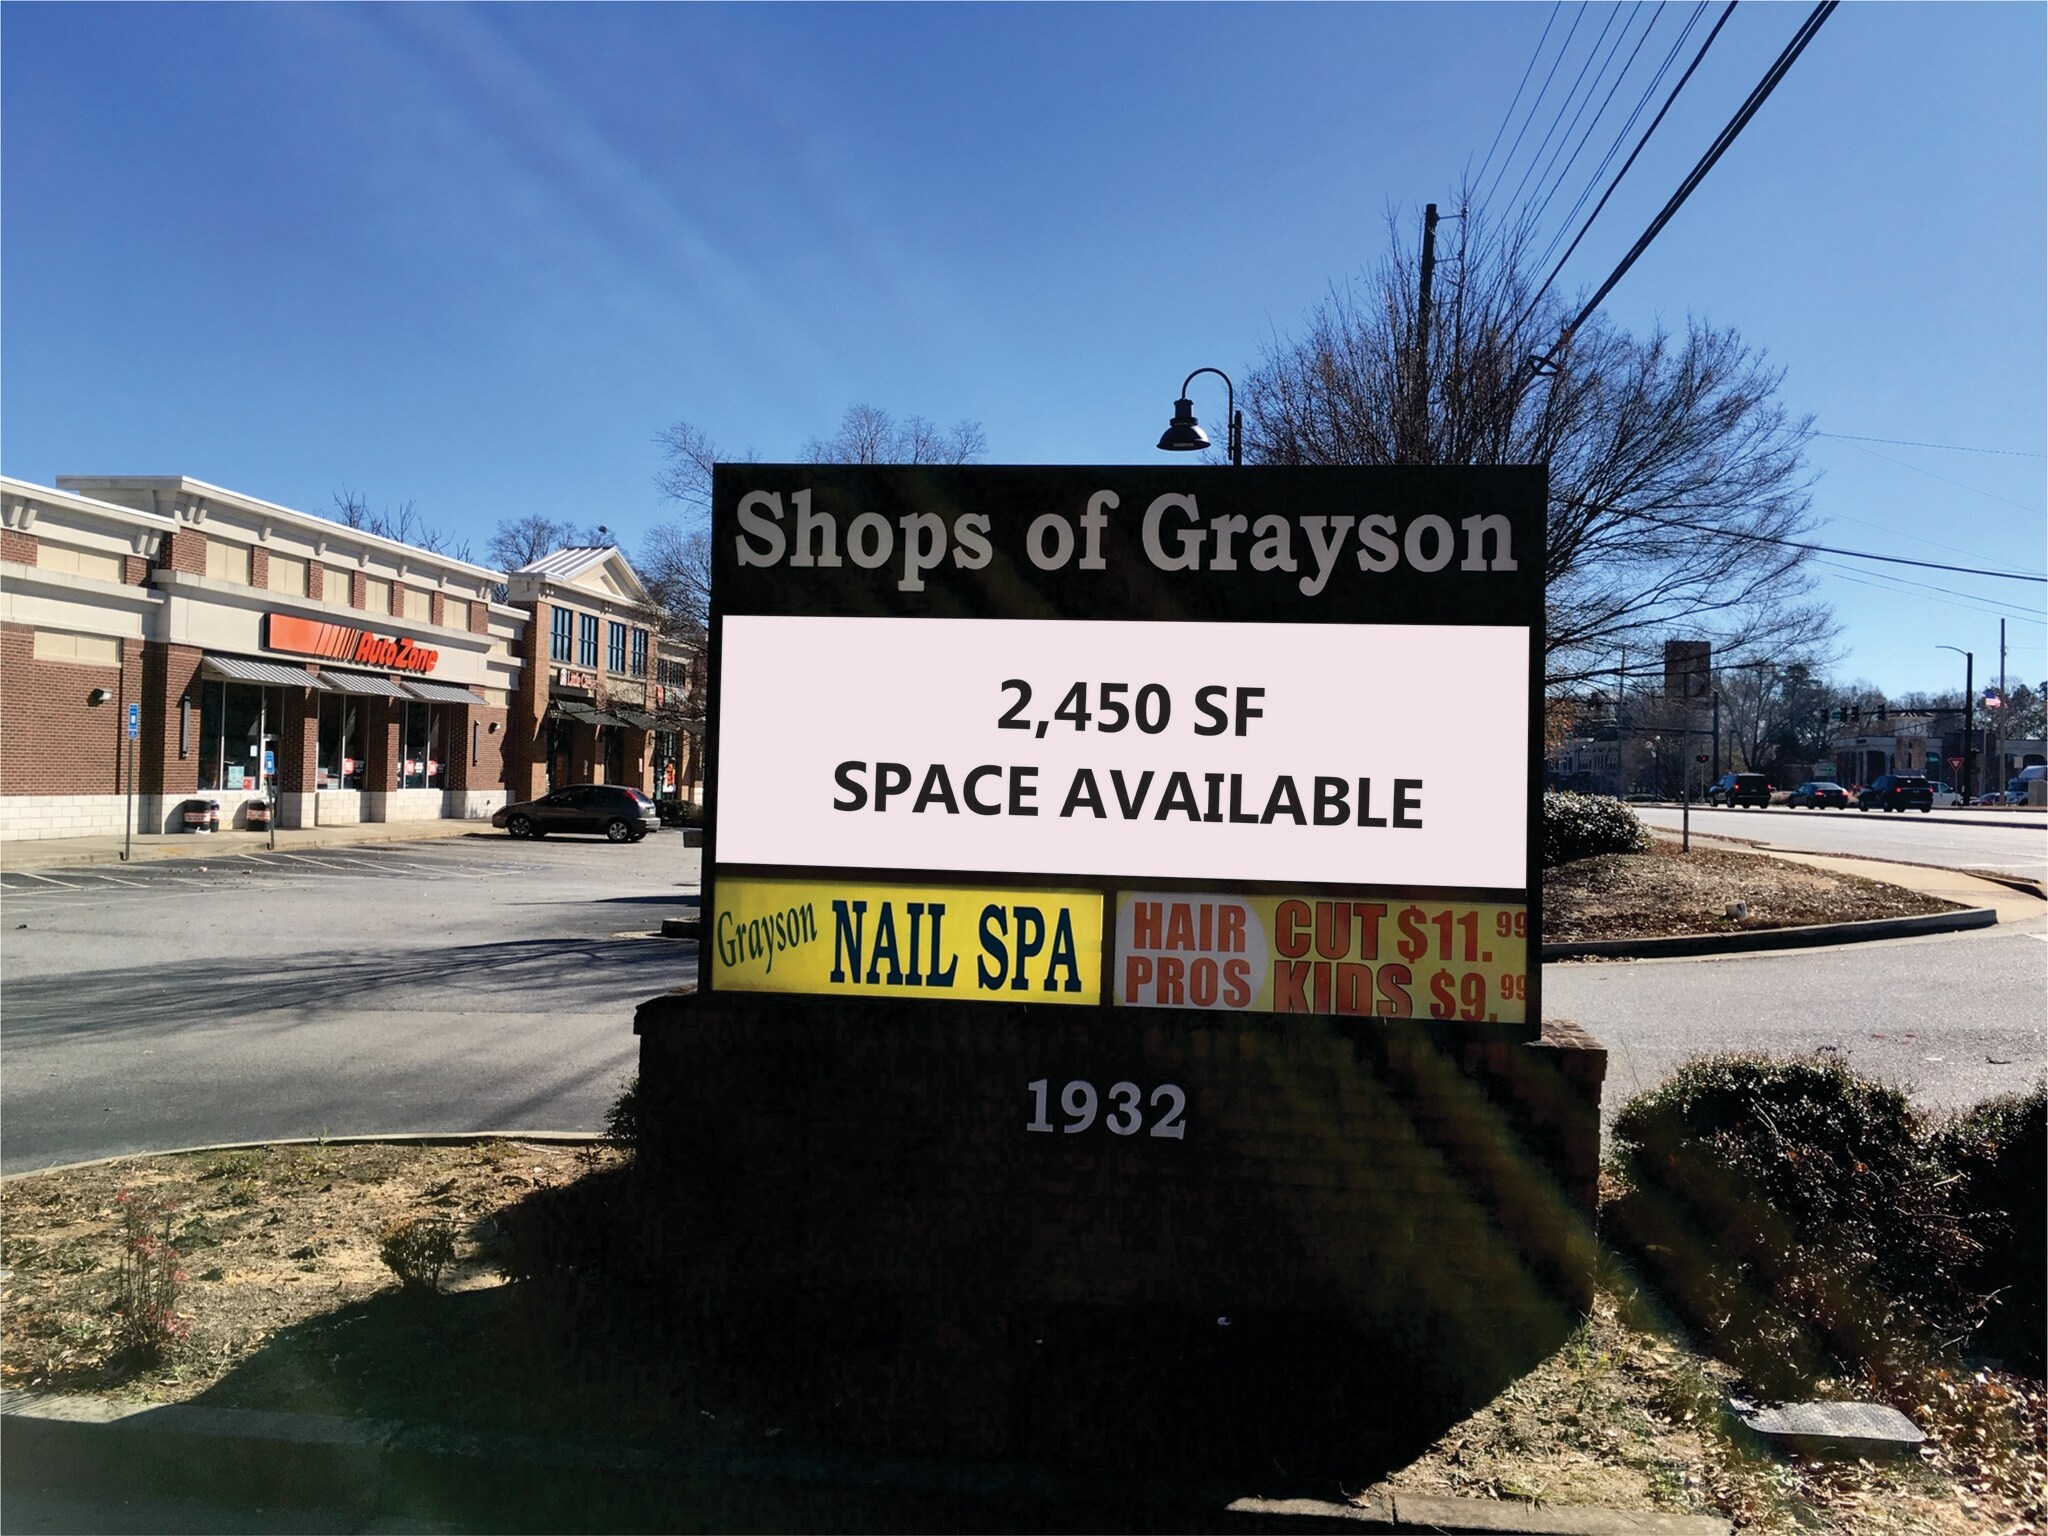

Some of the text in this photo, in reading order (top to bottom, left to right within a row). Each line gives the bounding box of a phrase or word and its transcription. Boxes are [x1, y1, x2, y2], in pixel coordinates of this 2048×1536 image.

[735, 489, 1519, 596] Shops of Grayson
[355, 631, 439, 673] AutoZone
[998, 679, 1266, 739] 2,450 SF
[833, 761, 1424, 829] SPACE AVAILABLE
[717, 900, 1082, 992] Grayson NAIL SPA
[1134, 902, 1247, 953] HAIR
[1275, 899, 1388, 960] CUT
[1126, 955, 1251, 1008] PROS
[1274, 960, 1413, 1018] KIDS
[1025, 1079, 1187, 1140] 1932
